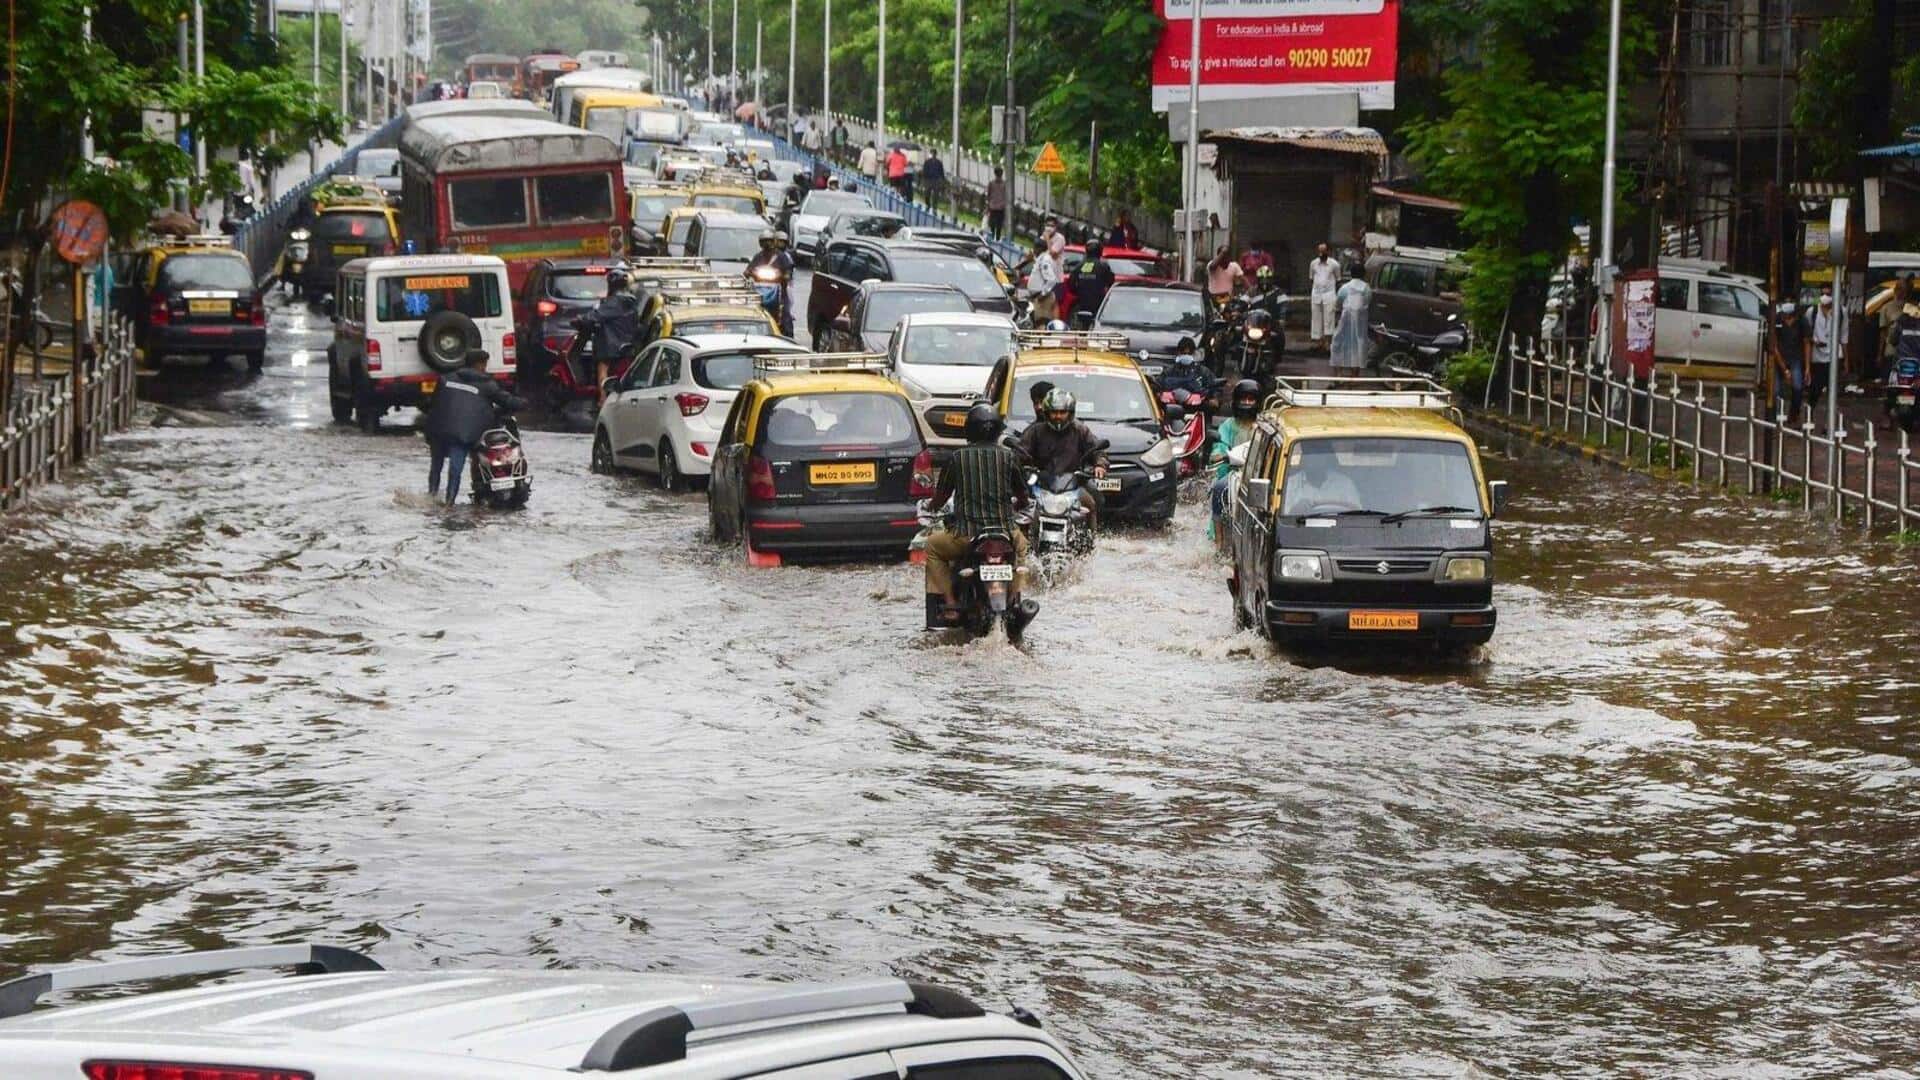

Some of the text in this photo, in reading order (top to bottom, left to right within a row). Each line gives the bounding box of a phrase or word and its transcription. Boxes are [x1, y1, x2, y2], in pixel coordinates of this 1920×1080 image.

[1216, 20, 1325, 34] For education in India & abroad
[1169, 55, 1180, 69] To
[1204, 56, 1221, 71] give
[1222, 58, 1228, 68] a
[1229, 56, 1258, 68] missed
[1259, 55, 1273, 68] call
[1274, 57, 1286, 67] on
[1288, 47, 1328, 68] 90290
[1331, 46, 1372, 68] 50027
[407, 276, 467, 289] AMBULANCE
